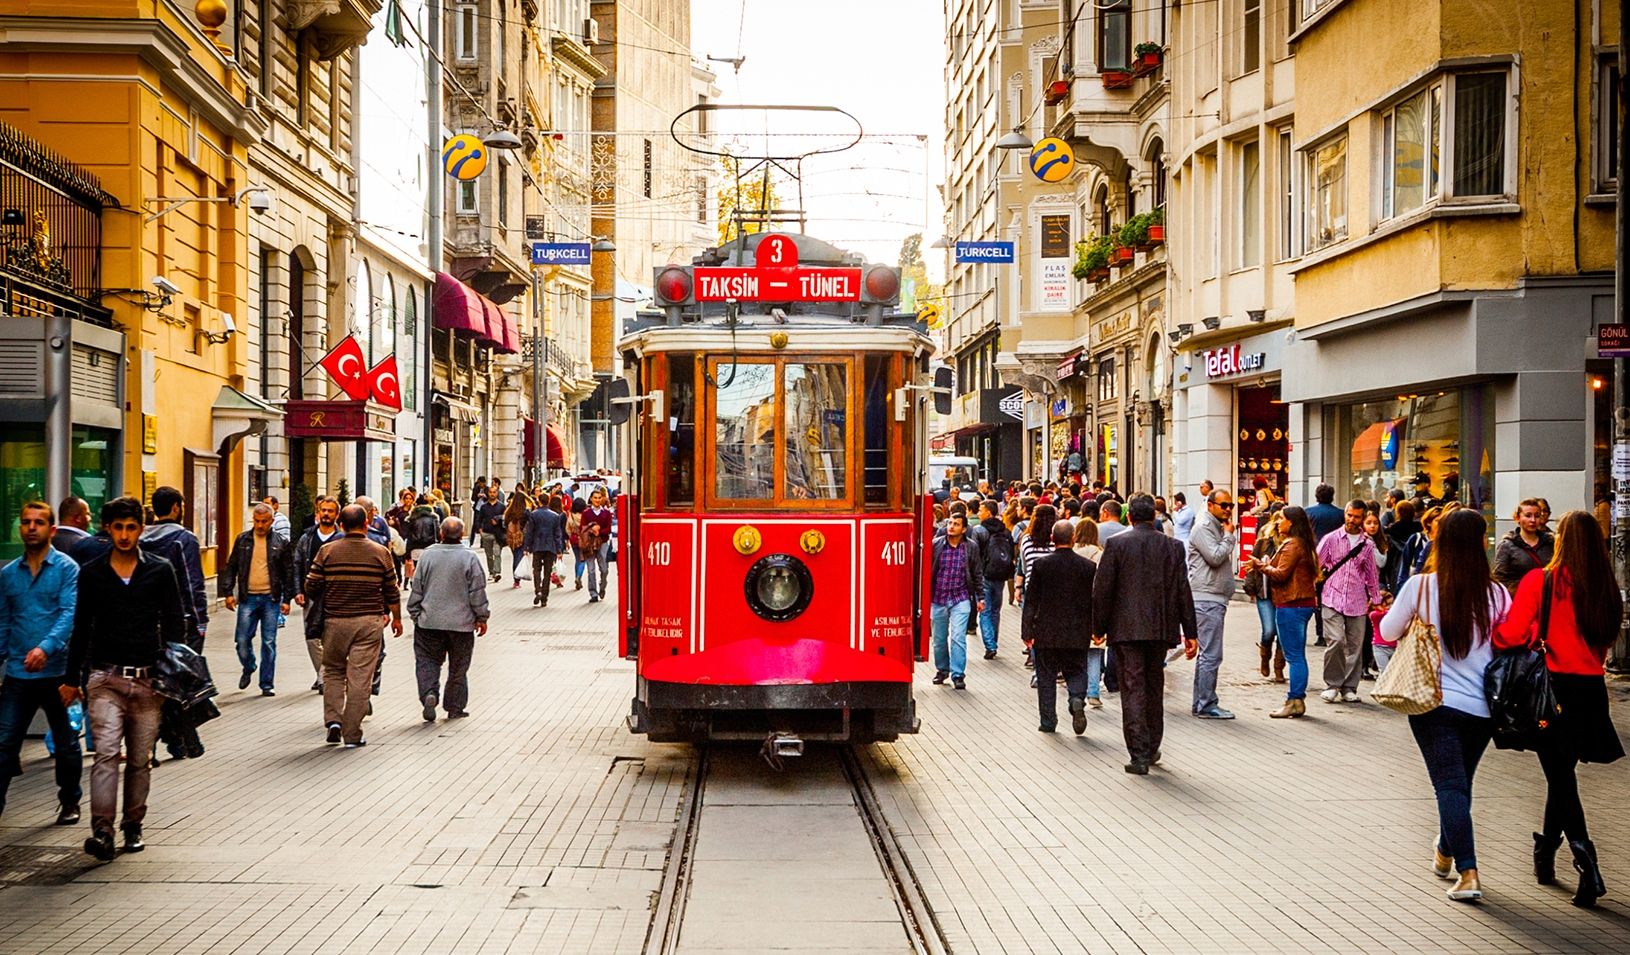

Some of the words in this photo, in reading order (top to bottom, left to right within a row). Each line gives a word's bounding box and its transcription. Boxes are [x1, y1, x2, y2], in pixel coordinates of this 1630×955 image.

[535, 248, 589, 260] TURKCELL
[771, 239, 783, 263] 3
[958, 247, 1011, 258] TURKCELL
[700, 273, 759, 297] TAKSİM
[799, 273, 855, 297] TÜNEL
[1600, 327, 1628, 338] GÖNÜL
[1203, 344, 1240, 377] Tefal
[648, 541, 670, 565] 410
[881, 541, 905, 565] 410
